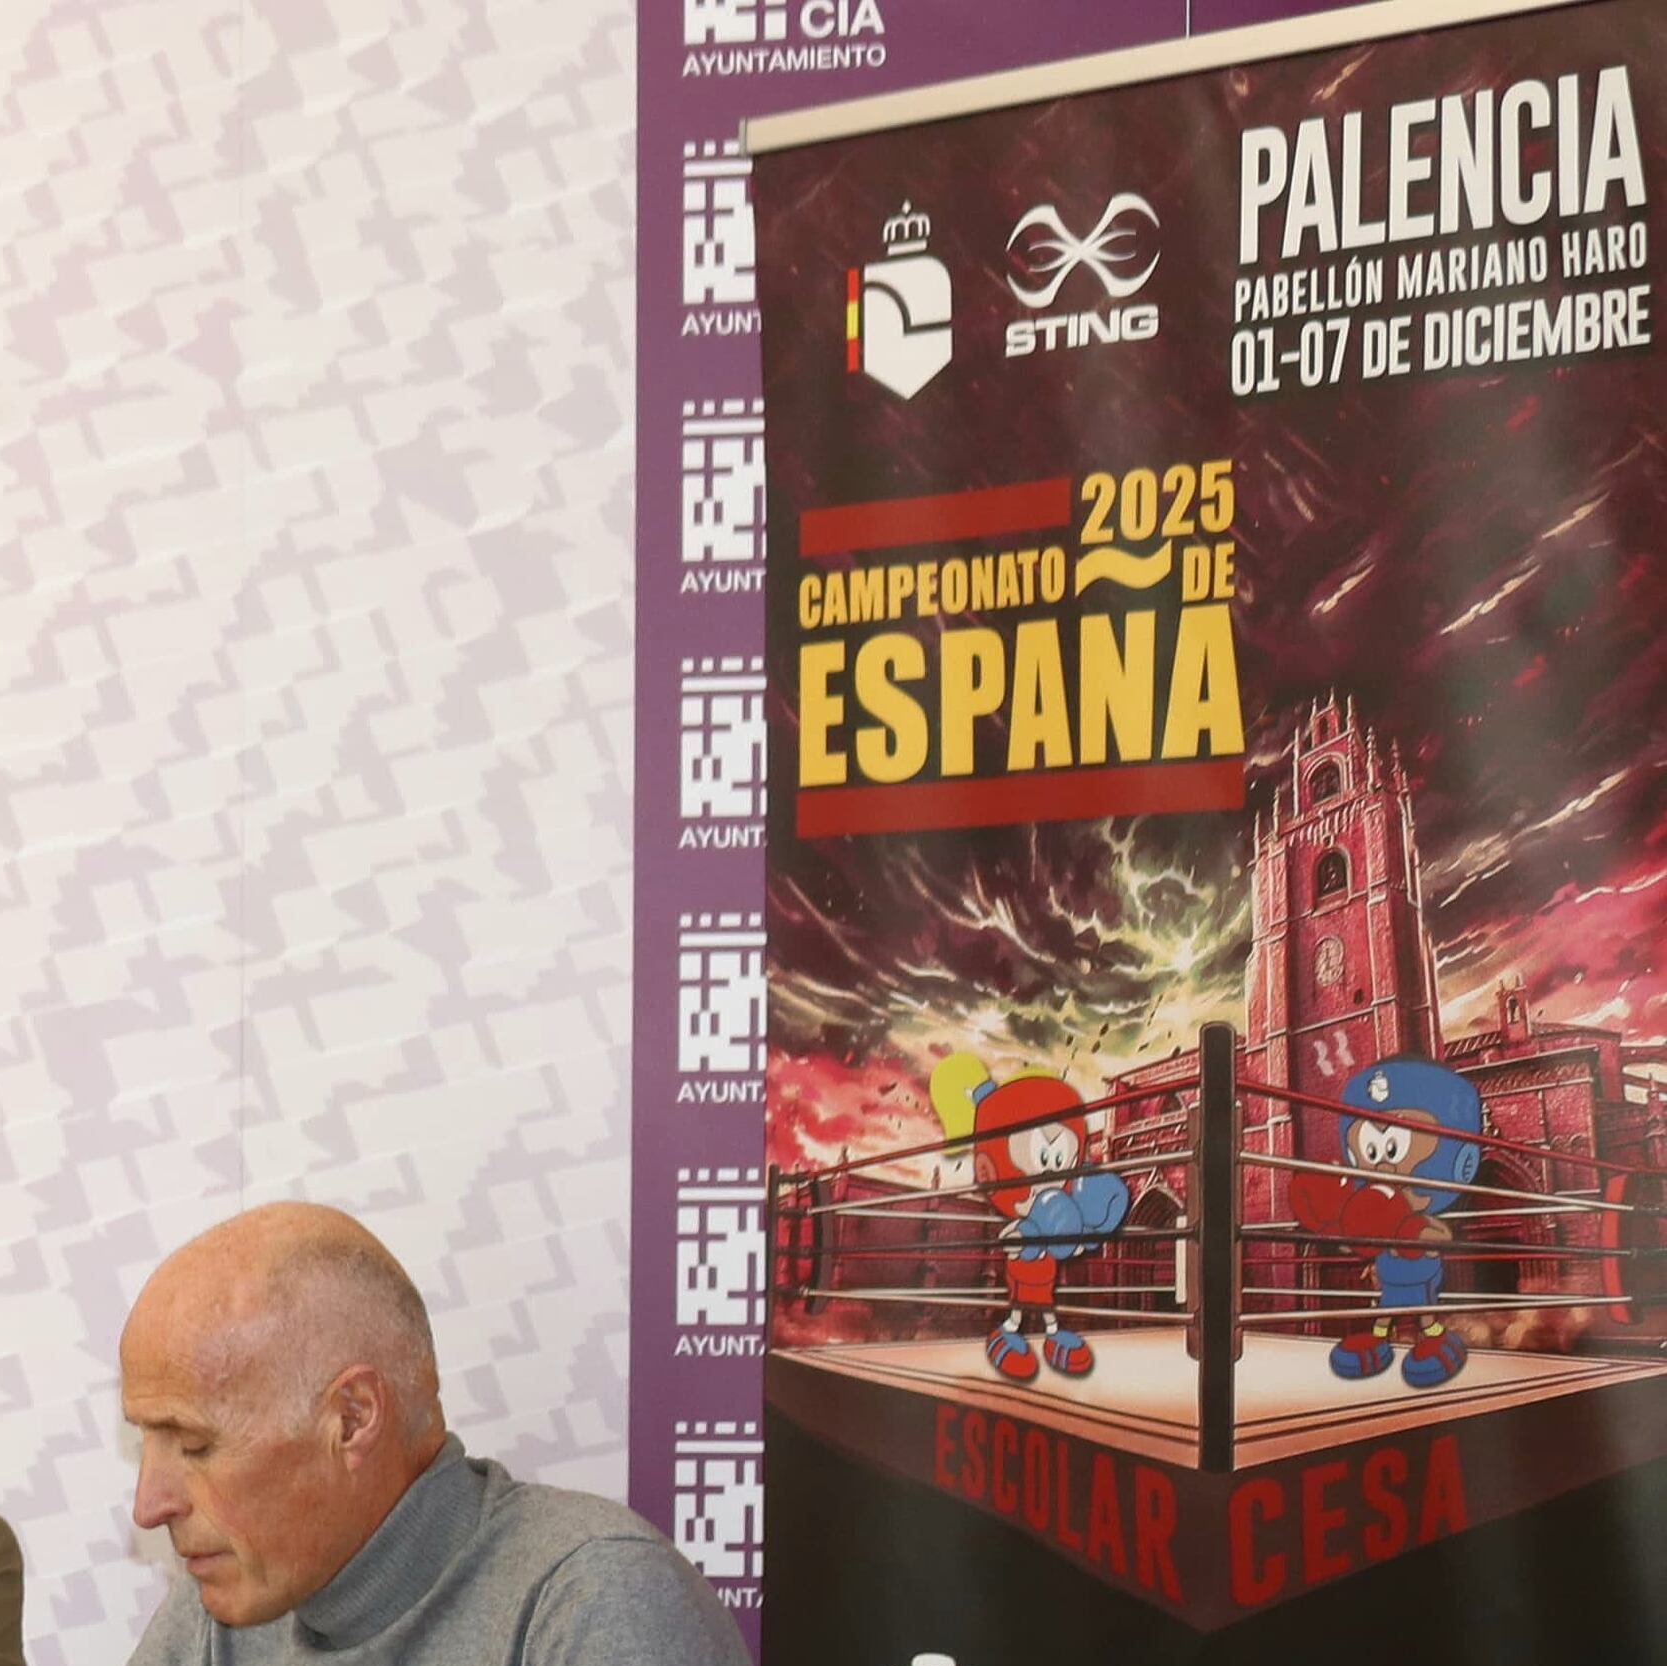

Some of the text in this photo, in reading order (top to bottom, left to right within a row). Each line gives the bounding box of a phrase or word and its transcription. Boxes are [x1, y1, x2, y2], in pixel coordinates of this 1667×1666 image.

[682, 45, 886, 77] AYUNTAMIENTO
[1239, 65, 1647, 265] PALENCIA
[1234, 221, 1647, 323] PABELLÓN MARIANO HARO
[1005, 304, 1159, 357] STING
[1231, 284, 1651, 396] 01-07 DE DICIEMBRE
[1081, 459, 1235, 544] 2025
[799, 542, 1235, 629] CAMPEONATO DE
[798, 541, 1246, 788] ESPAÑA
[679, 824, 766, 849] AYUNT
[677, 1080, 766, 1103] AYUNT
[675, 1334, 765, 1357] AYUNT
[935, 1404, 1468, 1608] ESCOLAR CESA
